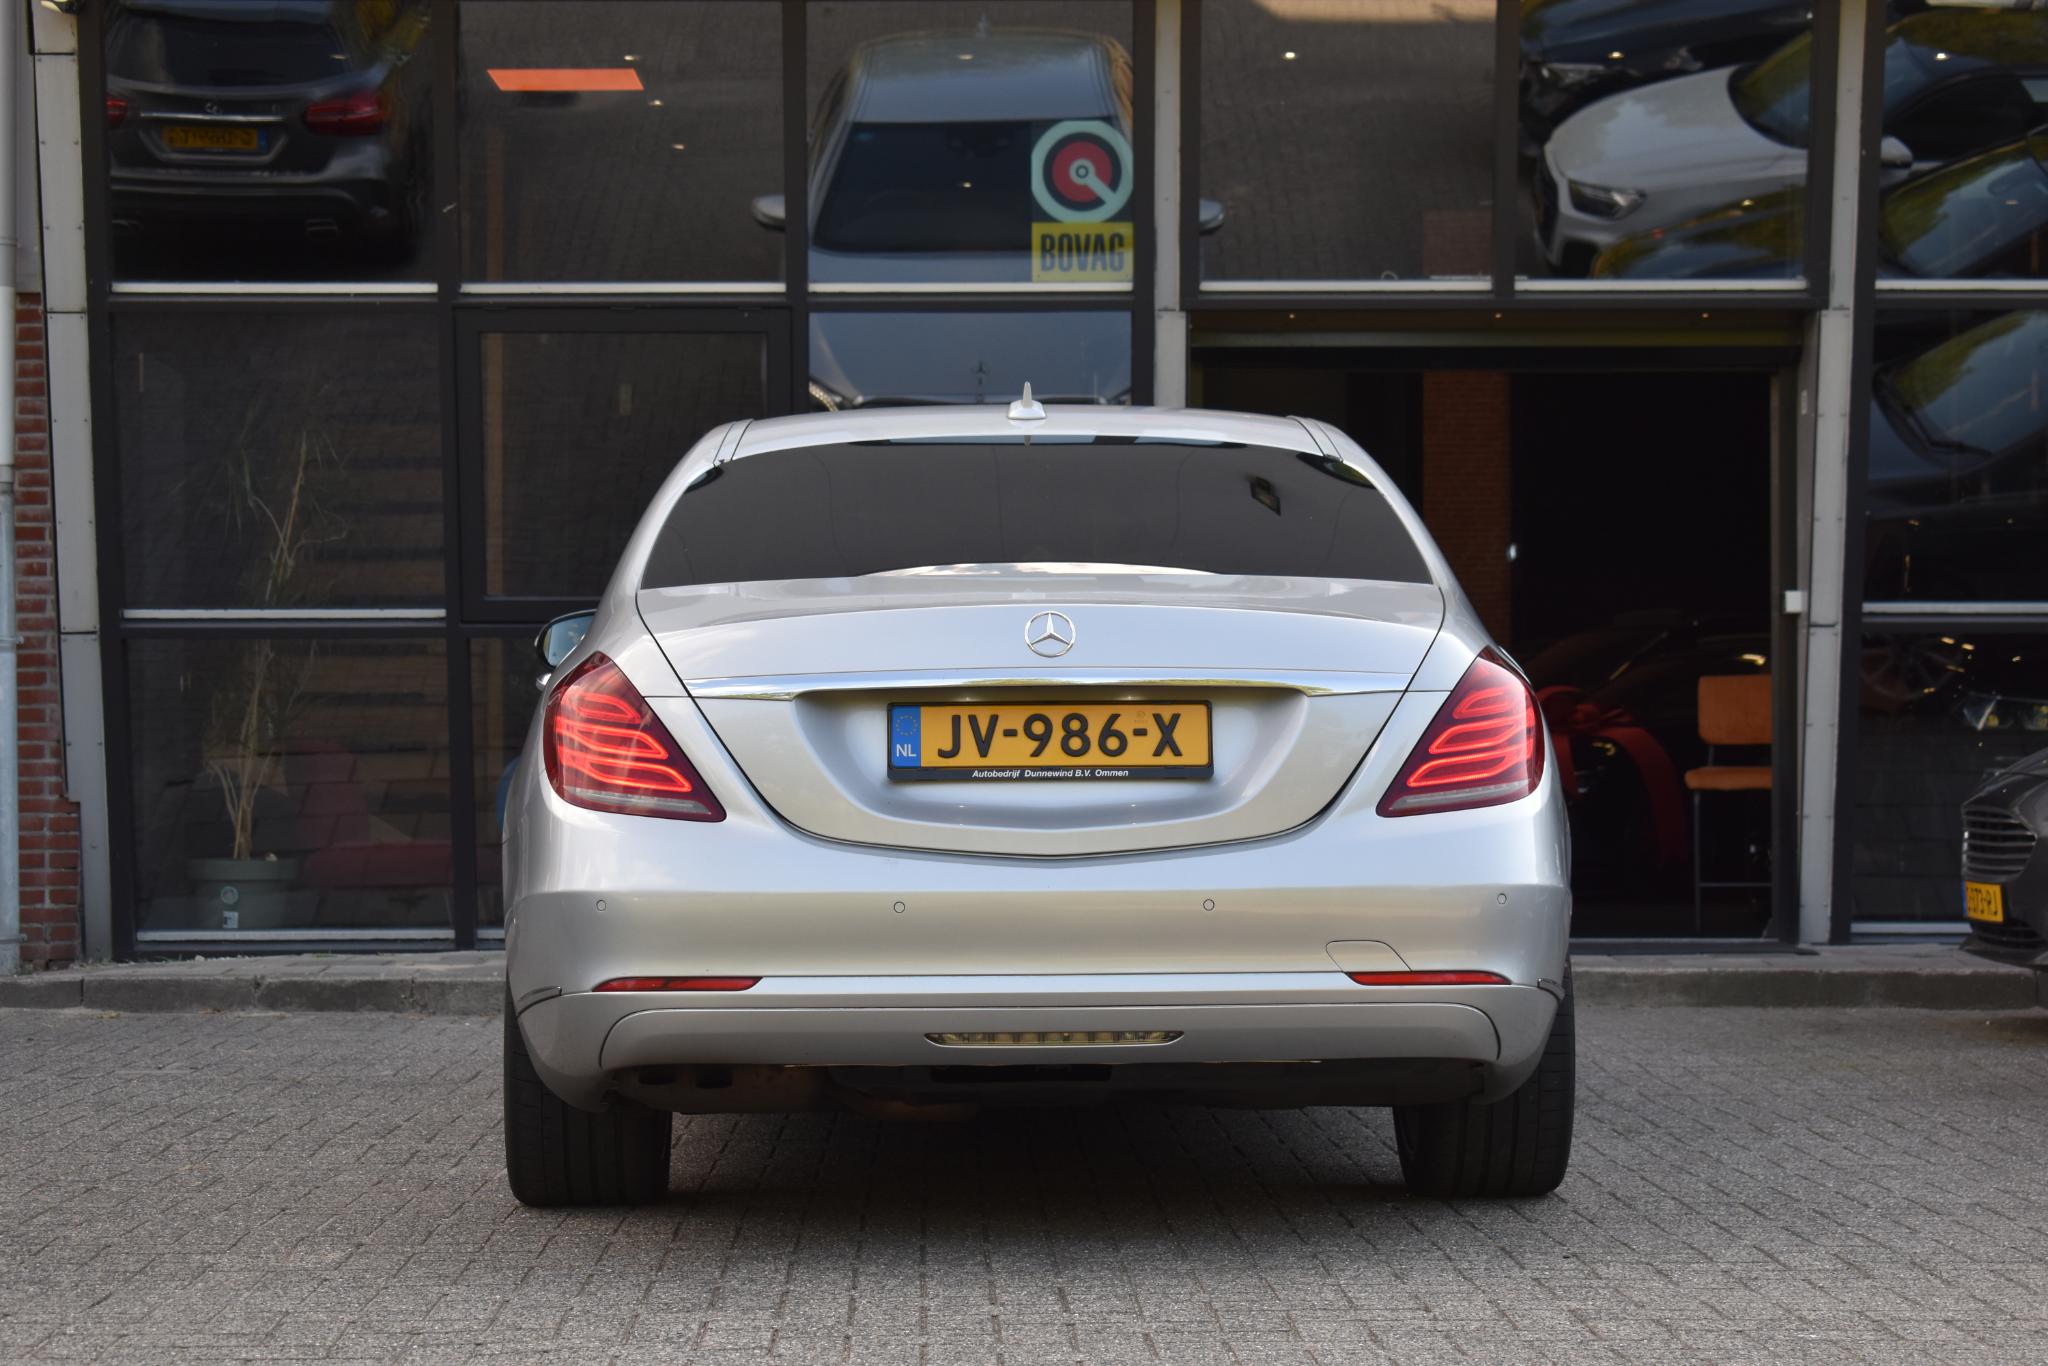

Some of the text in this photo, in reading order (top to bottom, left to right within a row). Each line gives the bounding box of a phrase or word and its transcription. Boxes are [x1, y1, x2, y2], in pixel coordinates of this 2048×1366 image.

[1040, 233, 1125, 272] BOVAG
[937, 712, 1183, 758] JV-986-X
[895, 743, 917, 758] NL
[971, 768, 1129, 779] Autobedrijf Dunnewind B.V. Ommen
